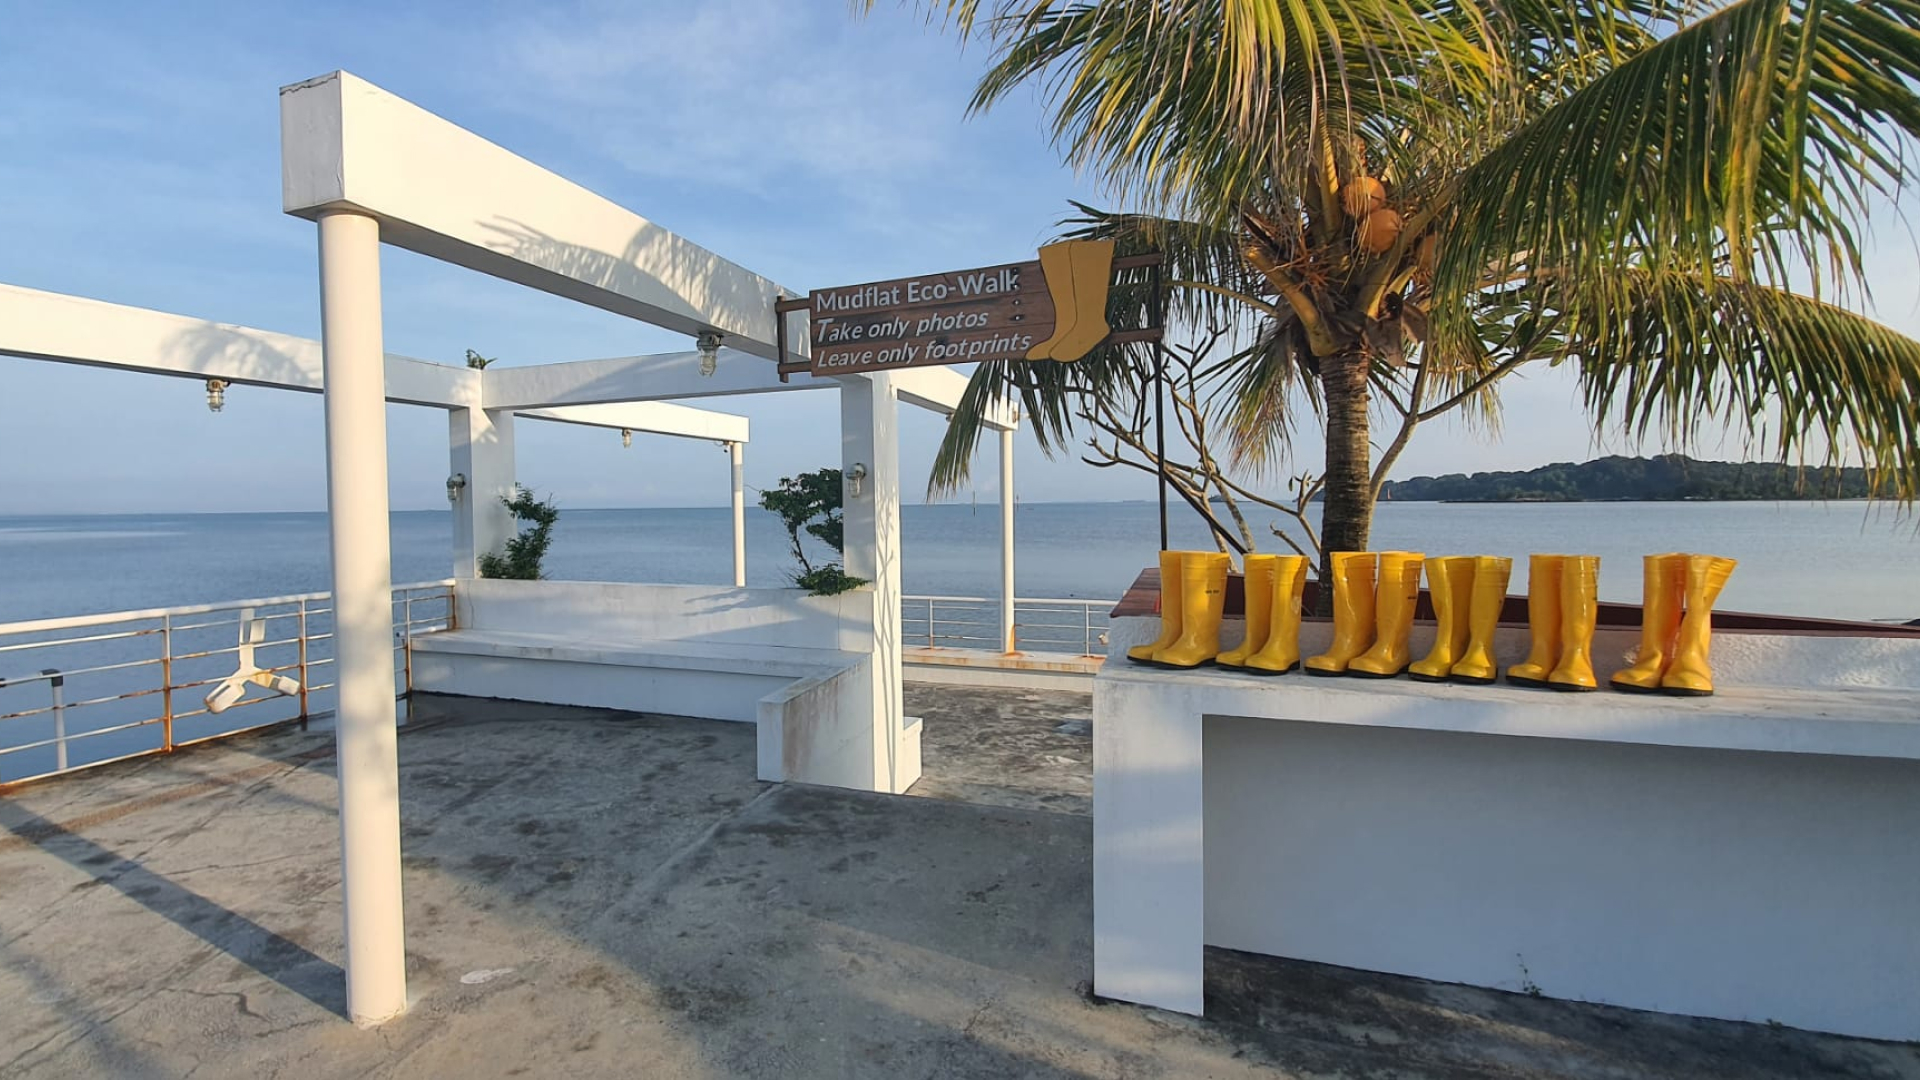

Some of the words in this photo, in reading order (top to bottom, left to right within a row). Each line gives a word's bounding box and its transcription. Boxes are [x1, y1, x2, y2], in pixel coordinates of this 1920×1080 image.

[816, 285, 900, 312] Mudflat
[907, 269, 1019, 303] Eco-Walk
[817, 318, 863, 342] Take
[868, 316, 910, 340] only
[915, 310, 989, 336] photos
[817, 349, 871, 368] Leave
[877, 342, 919, 365] only
[924, 333, 1031, 359] footprints
